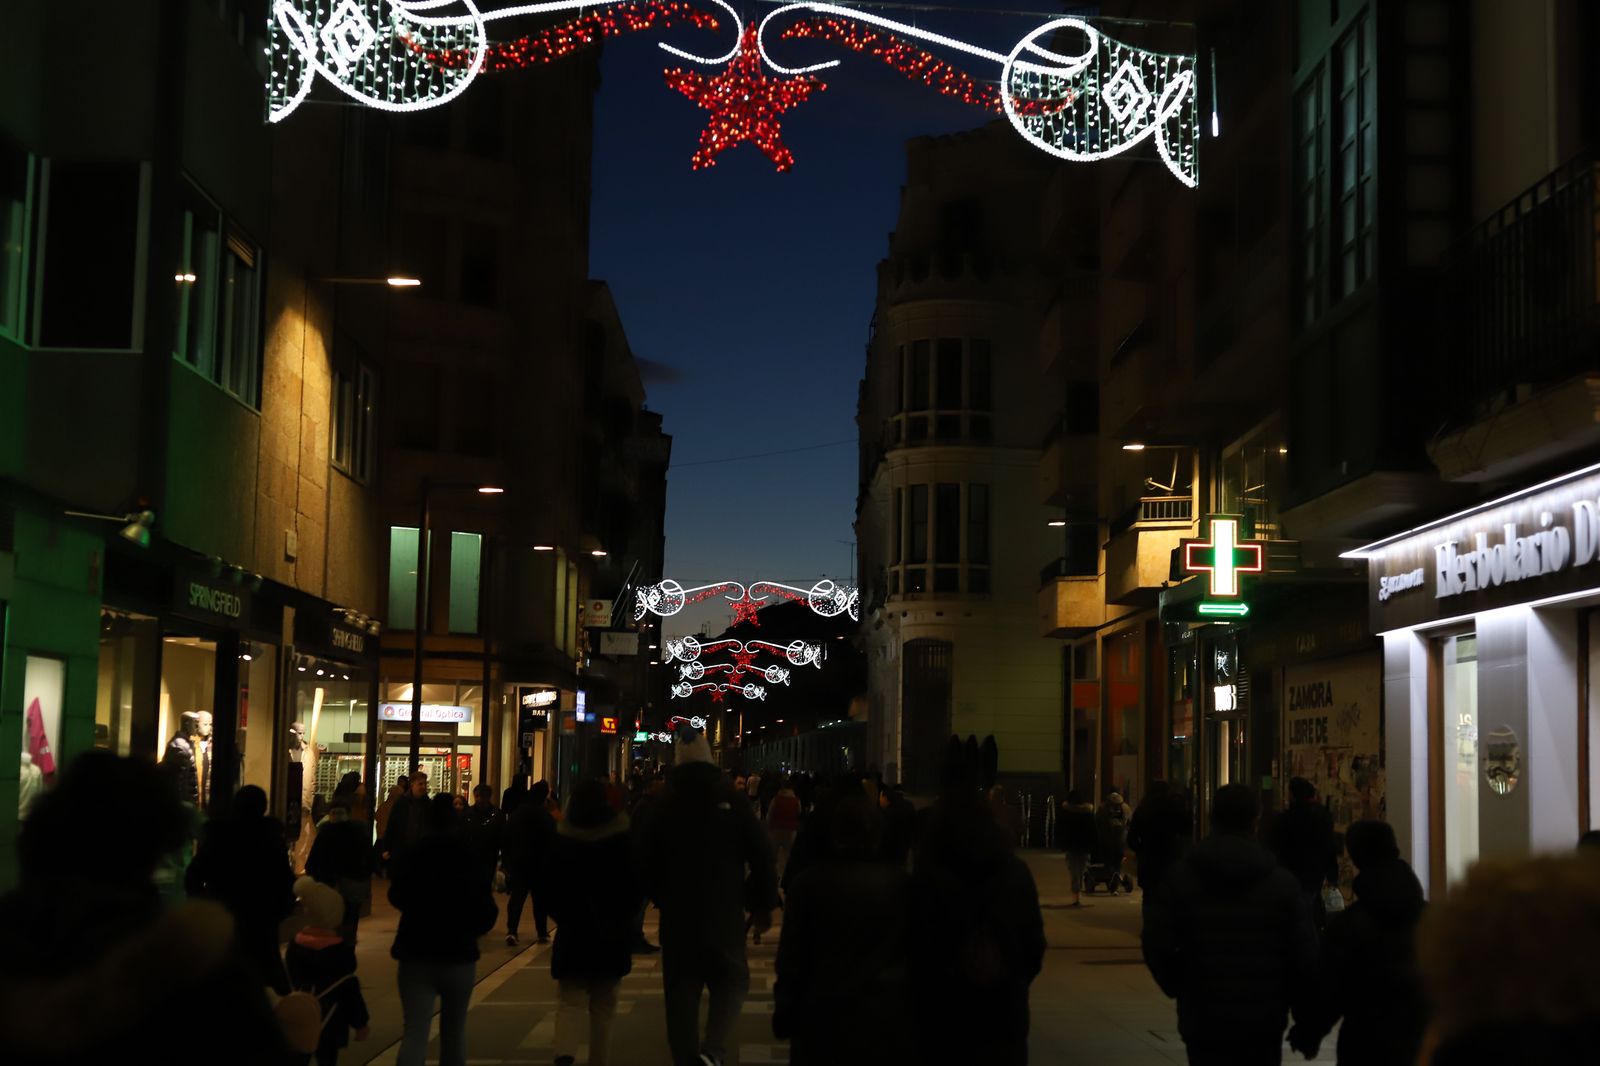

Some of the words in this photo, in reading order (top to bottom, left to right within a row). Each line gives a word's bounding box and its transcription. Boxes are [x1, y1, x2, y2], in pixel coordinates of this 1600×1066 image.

[1434, 512, 1570, 598] Herbolario
[1572, 498, 1600, 566] D
[188, 582, 241, 618] SPRINGFIELD
[1289, 681, 1333, 711] ZAMORA
[1289, 718, 1313, 745] LIBRE
[1316, 716, 1328, 744] DE
